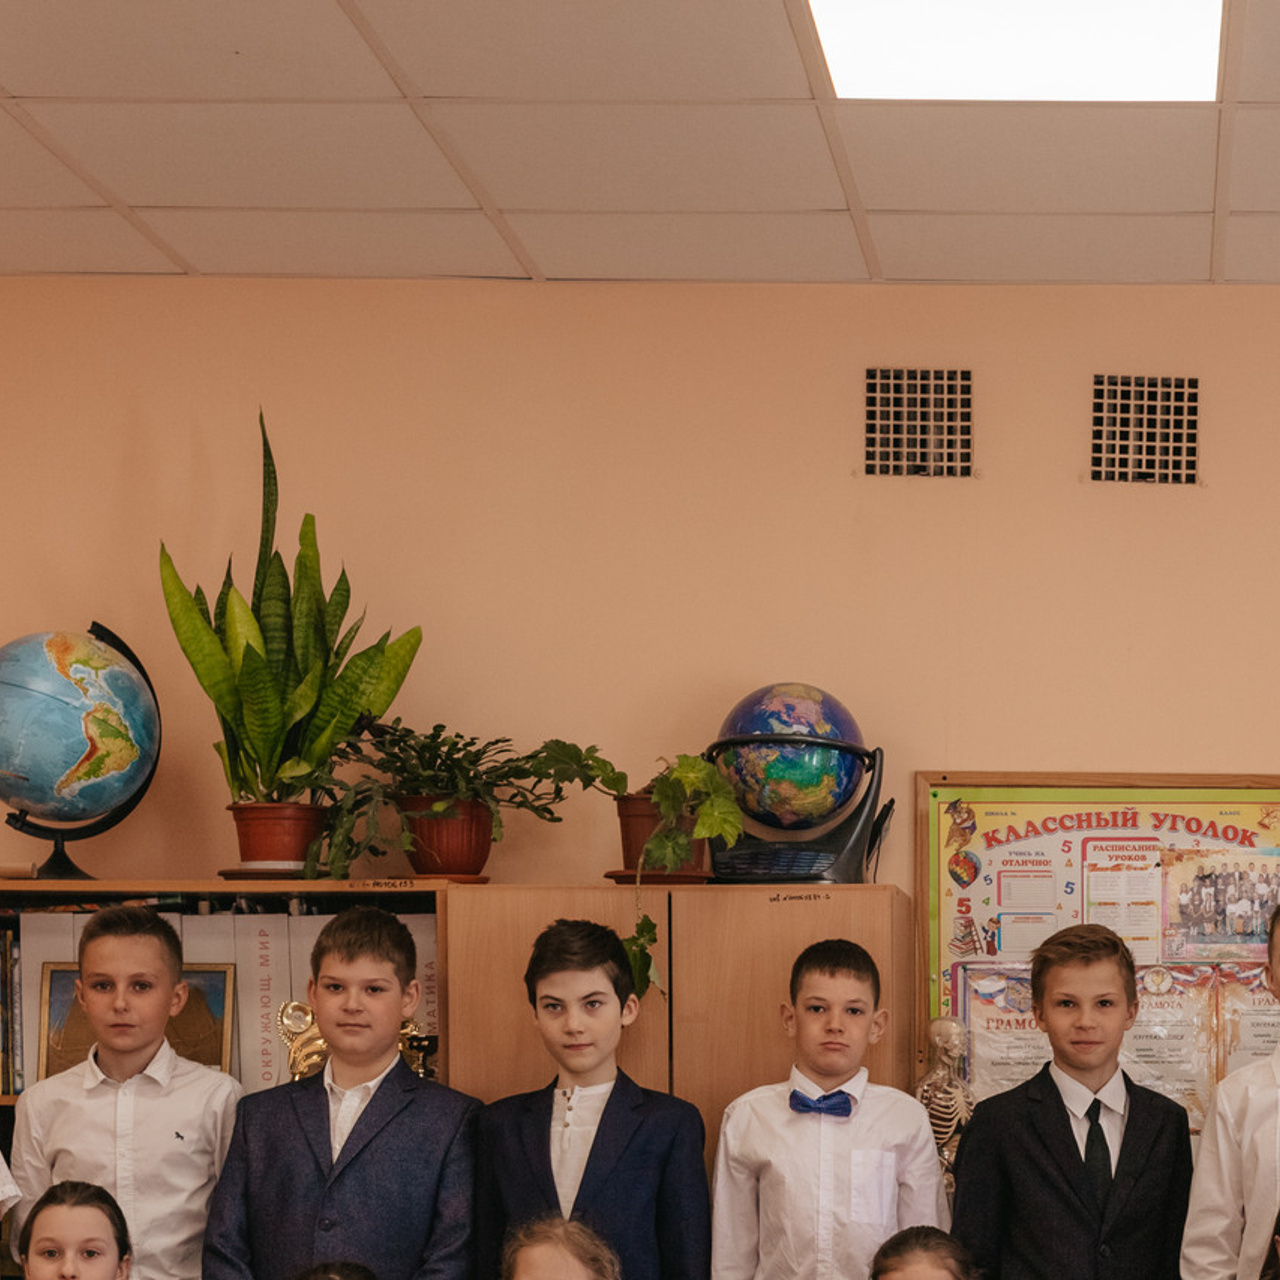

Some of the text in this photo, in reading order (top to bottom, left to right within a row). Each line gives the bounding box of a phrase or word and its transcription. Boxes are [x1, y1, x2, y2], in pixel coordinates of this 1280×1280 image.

[982, 807, 1259, 850] КЛАССНЫЙ УГОЛОК
[1061, 839, 1073, 853] 5
[1092, 844, 1158, 852] РАСПИСАНИЕ
[1001, 859, 1052, 867] ОТЛИЧНО!
[1107, 854, 1147, 862] УРОКОВ
[983, 874, 993, 886] 5
[1063, 881, 1075, 895] 5
[957, 897, 972, 915] 5
[1071, 909, 1079, 919] 3
[258, 928, 271, 967] МИР
[942, 968, 953, 982] 5
[941, 997, 950, 1008] 4
[1139, 1000, 1184, 1010] ГРАМОТА
[986, 1018, 1039, 1030] ГРАМО
